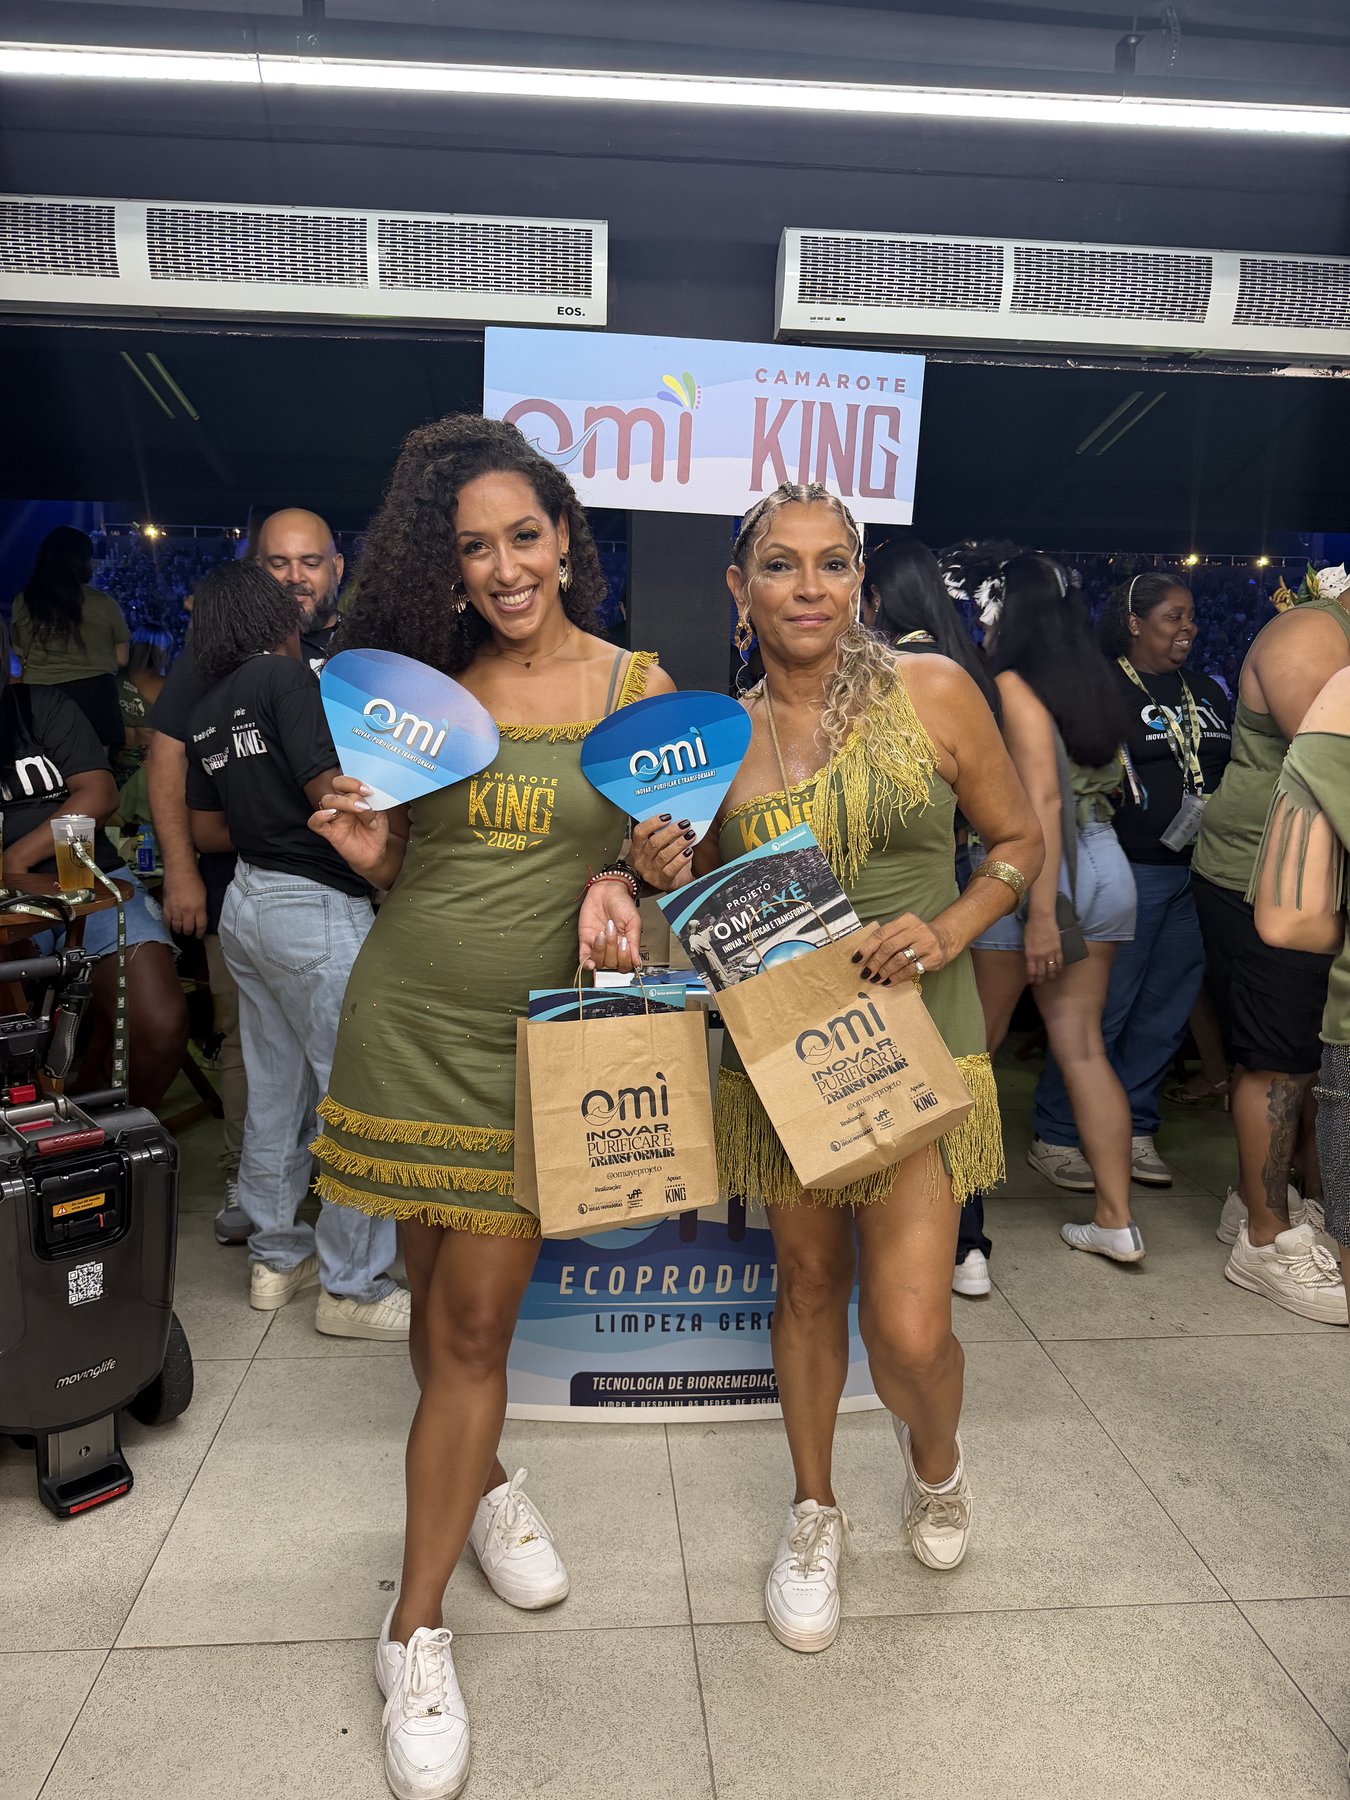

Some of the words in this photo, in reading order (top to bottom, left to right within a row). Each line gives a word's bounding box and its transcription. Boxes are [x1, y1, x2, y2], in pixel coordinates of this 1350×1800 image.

[557, 306, 586, 317] EOS.
[755, 367, 907, 394] CAMAROTE
[748, 396, 902, 500] KING
[371, 737, 398, 753] PURIFICAR
[473, 771, 559, 786] AMAROTE
[653, 779, 678, 791] PURIFICAR
[468, 779, 555, 835] KING
[740, 792, 811, 817] CAMAROT
[739, 800, 814, 852] KIN
[487, 830, 528, 851] 2026
[726, 882, 771, 911] PROJETO
[721, 938, 745, 954] INOVAR,
[816, 1050, 892, 1096] PURIFICAR
[888, 1045, 902, 1060] E
[822, 1057, 910, 1105] TRANSFORMAR
[912, 1091, 939, 1113] KING
[587, 1134, 661, 1157] PURIFICAR
[662, 1132, 673, 1147] E
[588, 1146, 676, 1168] TRANSFORMAR
[665, 1187, 687, 1203] KING
[595, 1312, 702, 1333] LIMPEZA
[55, 1358, 117, 1388] movinglife
[593, 1376, 665, 1391] TECNOLOGIA
[668, 1376, 684, 1390] DE
[687, 1373, 778, 1391] BIORREMEDIAÇ
[750, 1397, 779, 1405] ESGOT
